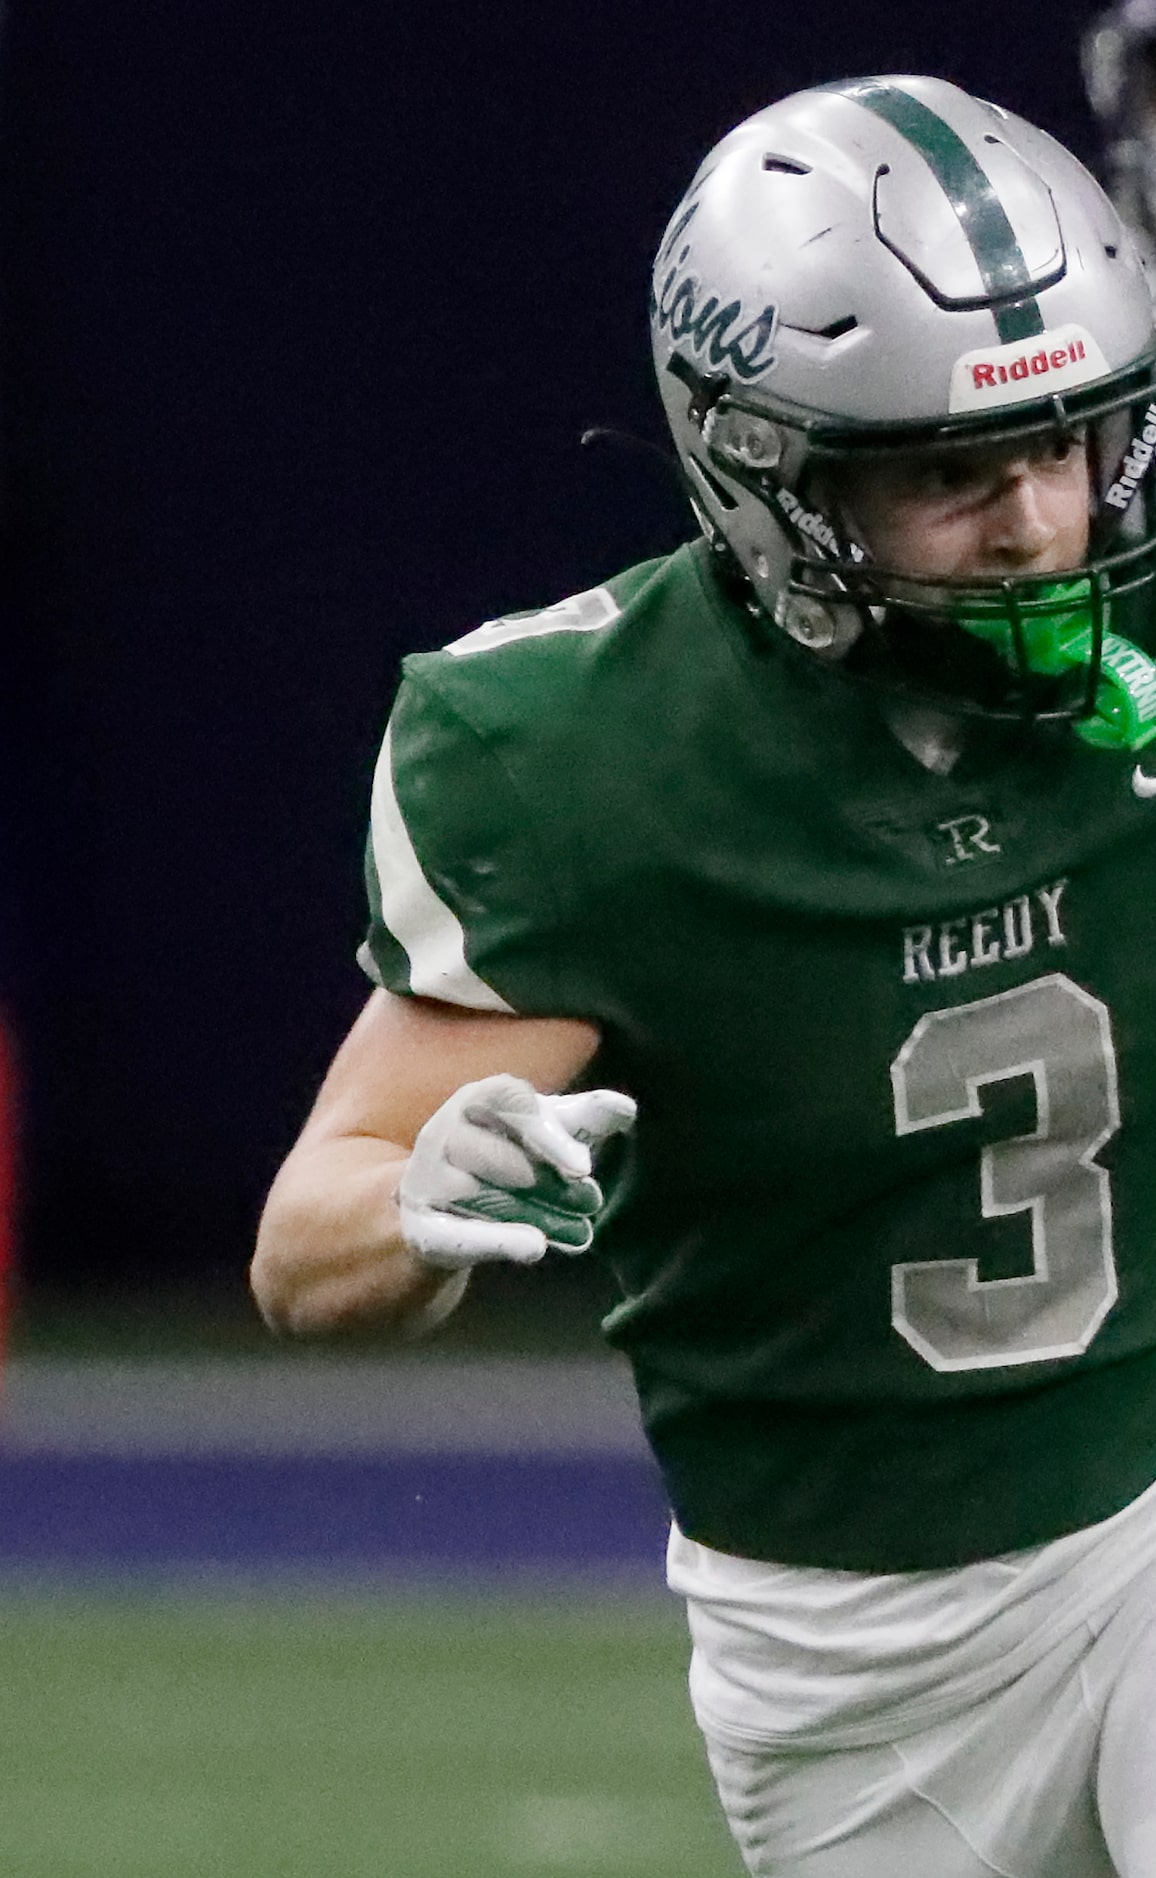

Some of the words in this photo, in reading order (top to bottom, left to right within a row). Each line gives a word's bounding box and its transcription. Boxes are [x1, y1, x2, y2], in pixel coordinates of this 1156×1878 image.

[972, 340, 1086, 390] Riddell
[937, 814, 1001, 865] R
[902, 877, 1068, 985] REEDY
[891, 973, 1121, 1372] 3
